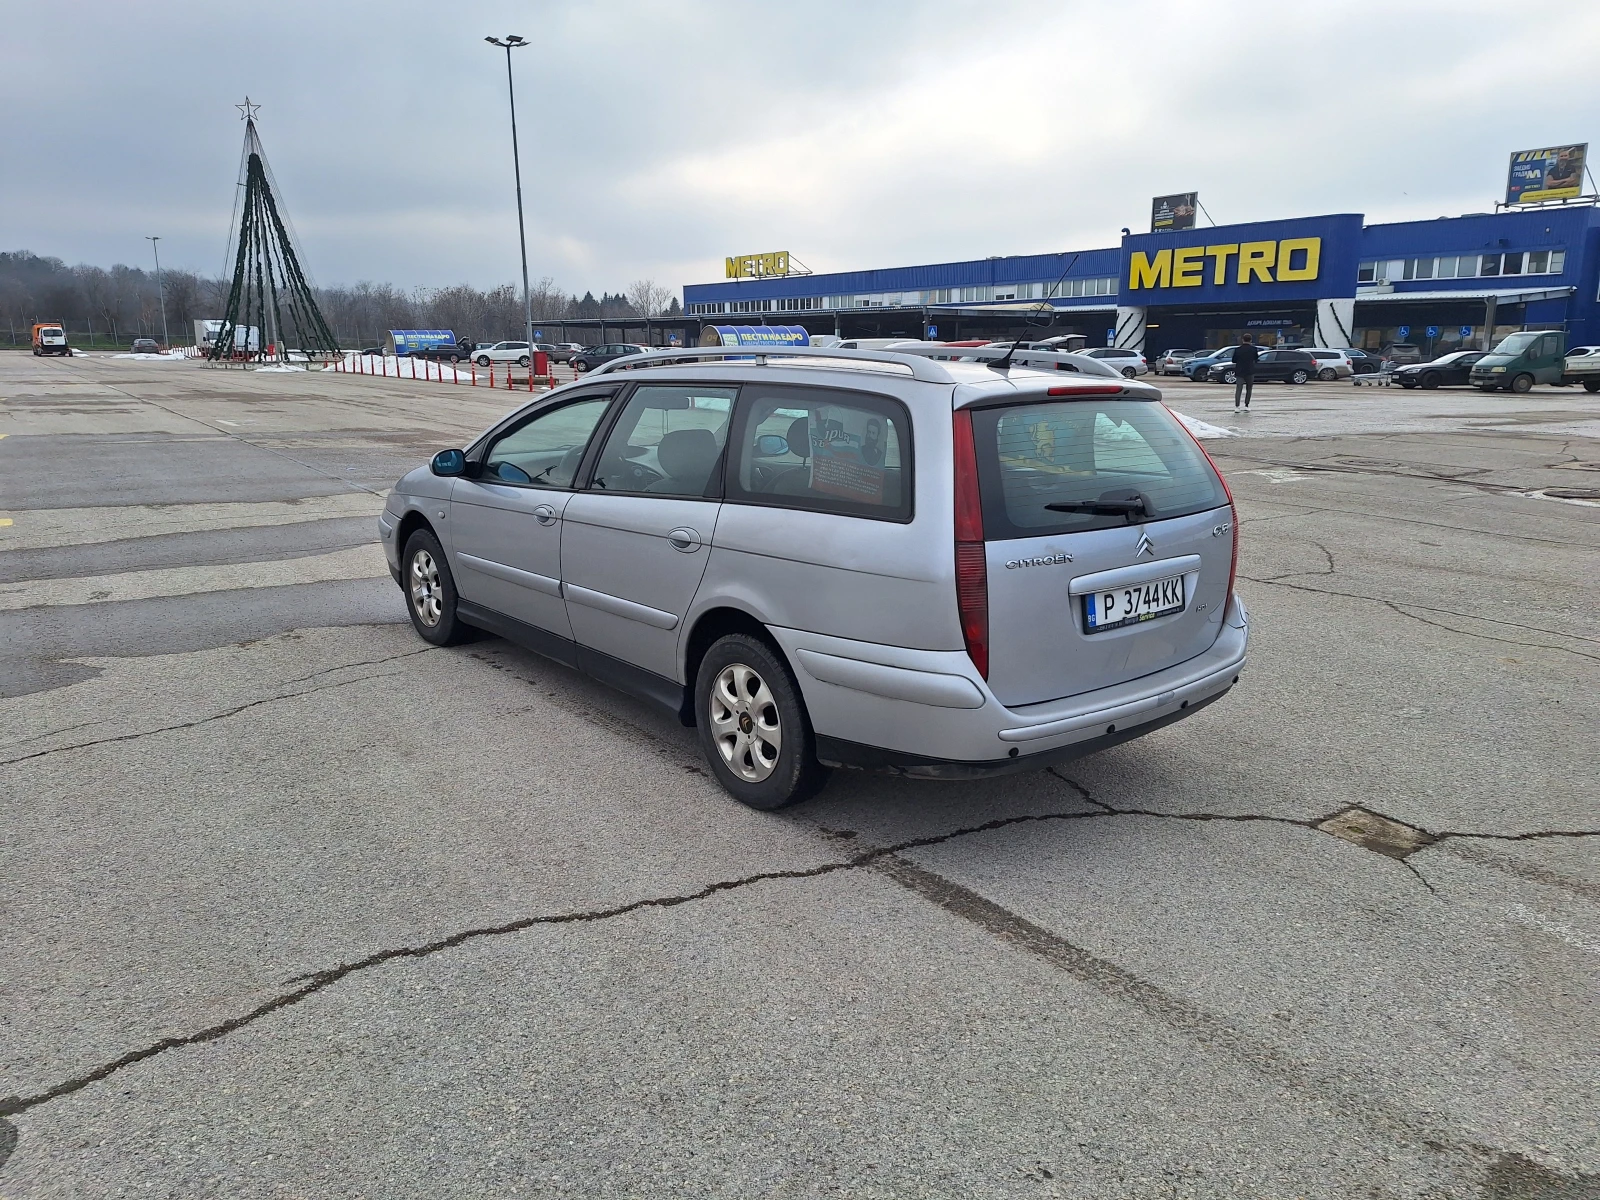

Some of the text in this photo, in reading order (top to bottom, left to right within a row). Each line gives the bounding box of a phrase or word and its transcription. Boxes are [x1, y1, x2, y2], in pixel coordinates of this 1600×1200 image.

[726, 251, 789, 278] METRO
[1129, 237, 1321, 290] METRO
[1213, 523, 1229, 537] C5
[1005, 553, 1074, 569] CITROËN
[1104, 594, 1115, 620] P
[1088, 614, 1096, 623] BG
